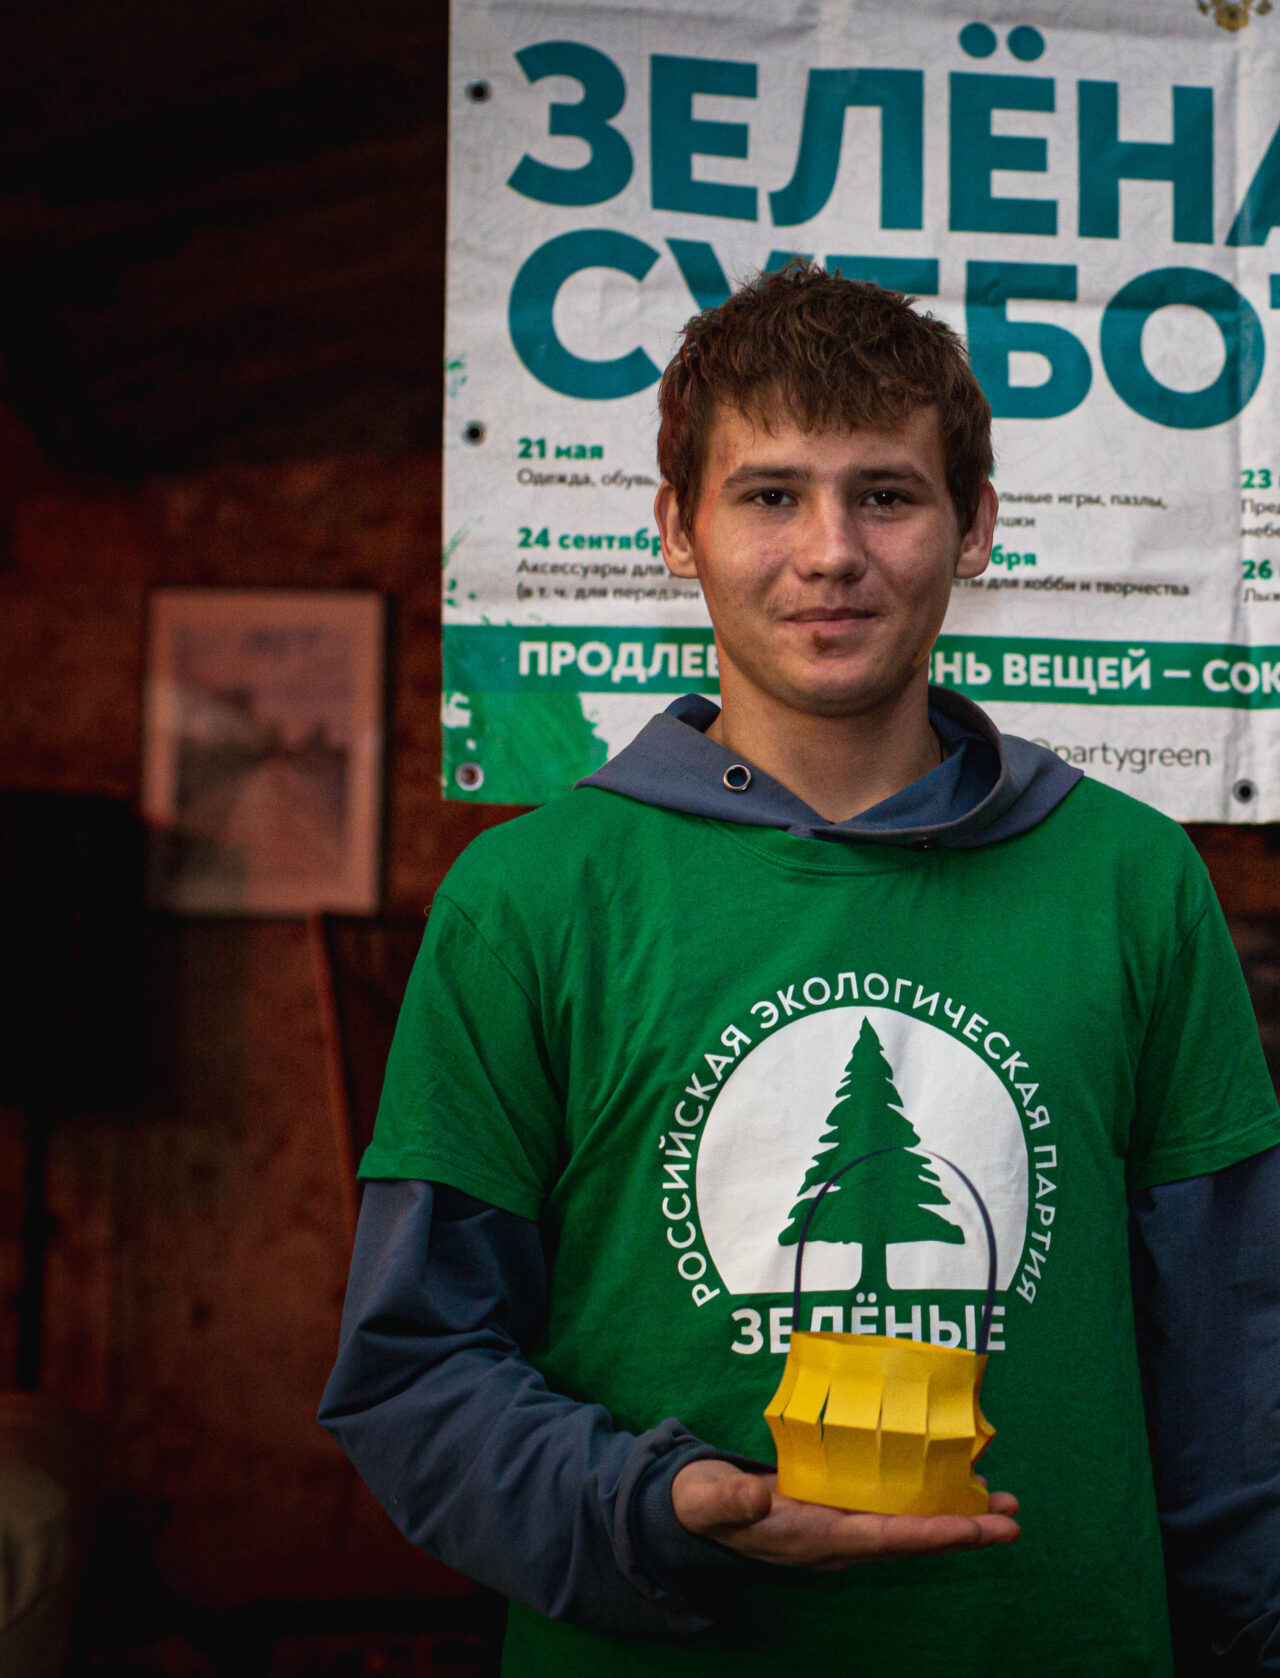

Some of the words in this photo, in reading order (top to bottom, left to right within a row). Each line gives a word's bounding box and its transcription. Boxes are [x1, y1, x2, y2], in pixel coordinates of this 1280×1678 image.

[518, 437, 546, 459] 21
[555, 444, 604, 460] мая
[517, 468, 596, 487] Одежда,
[1241, 469, 1272, 490] 23
[518, 527, 550, 548] 24
[558, 527, 662, 557] сентябр
[517, 559, 627, 579] Аксессуары
[631, 563, 665, 577] для
[1242, 560, 1272, 580] 26
[986, 577, 1019, 591] для
[1023, 575, 1076, 592] хобби
[1095, 580, 1190, 597] творчества
[1003, 648, 1151, 695] ВЕЩЕЙ
[1032, 738, 1212, 774] partygreen
[659, 1024, 752, 1307] РОССИЙСКАЯ
[750, 972, 1052, 1131] ЭКОЛОГИЧЕСКАЯ
[1015, 1144, 1057, 1304] ПАРТИЯ
[731, 1292, 1006, 1356] ЗЕЛЁНЫЕ
